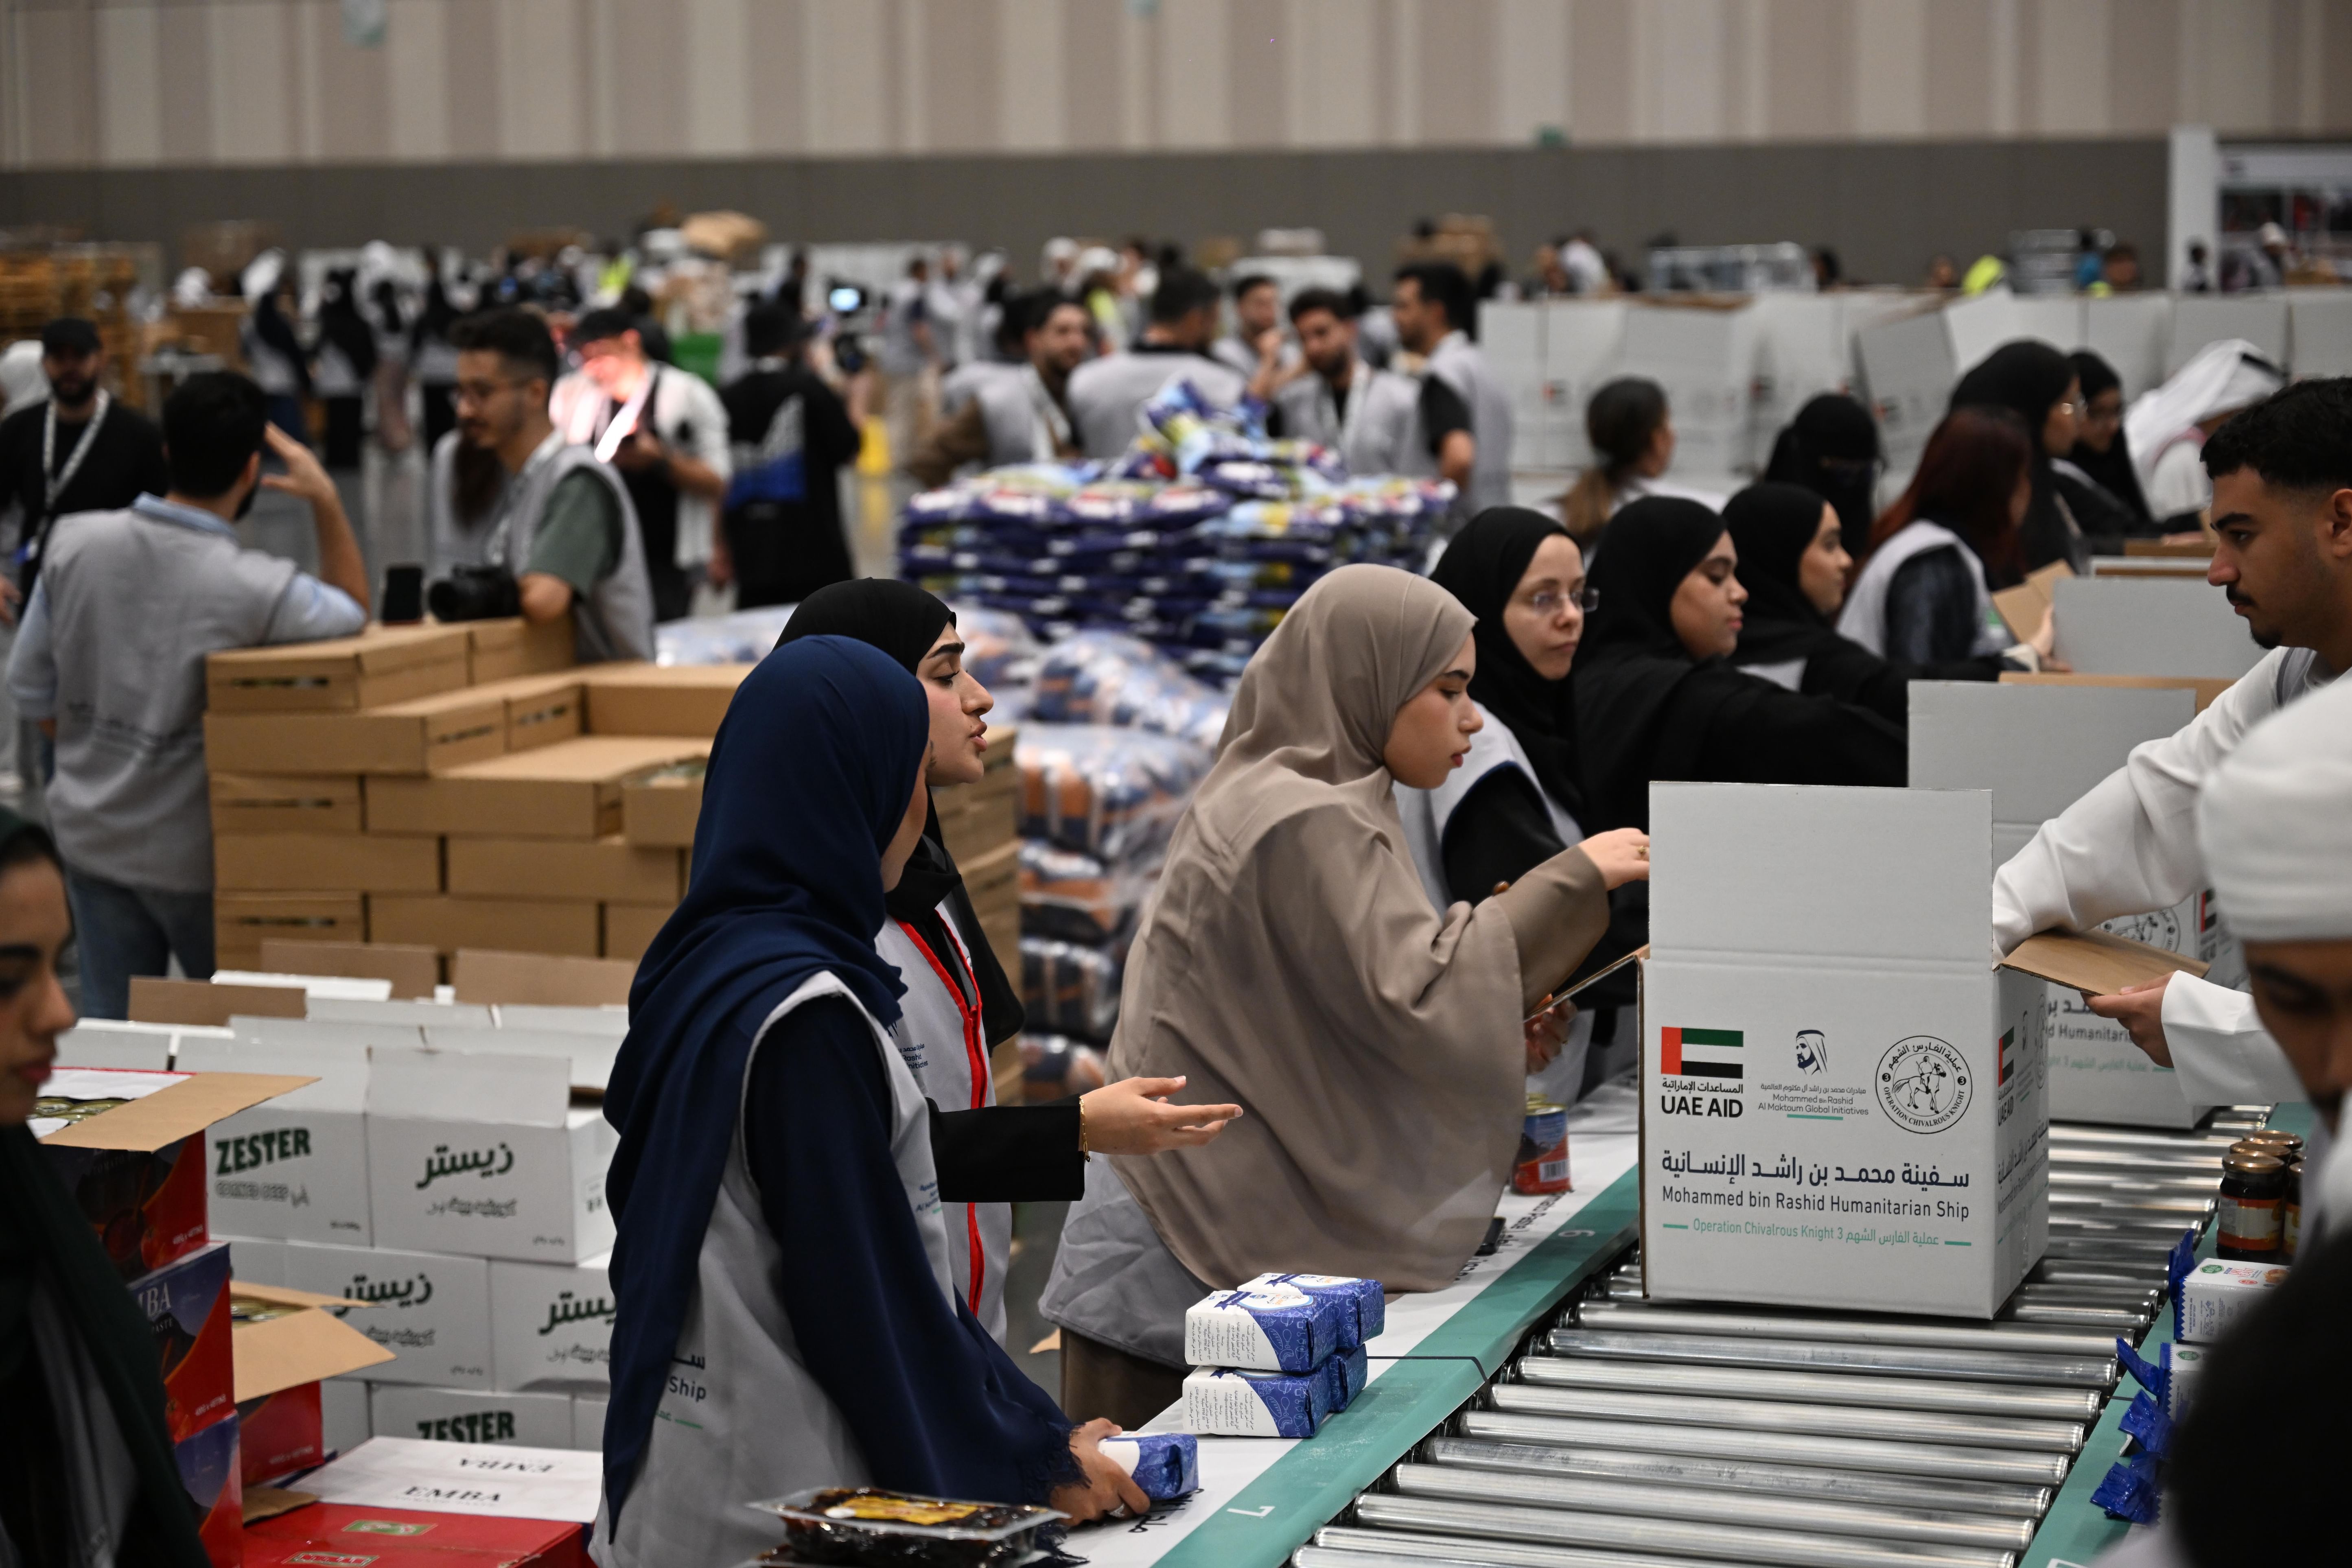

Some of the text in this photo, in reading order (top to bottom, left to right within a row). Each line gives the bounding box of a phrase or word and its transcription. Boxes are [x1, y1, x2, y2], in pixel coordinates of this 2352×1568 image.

[1888, 1042, 1962, 1073] عملية الفارس الشهم
[1662, 1078, 1744, 1094] المساعدات الإماراتية
[1761, 1083, 1782, 1091] العالمية
[1783, 1084, 1801, 1092] مكتوم
[1809, 1085, 1822, 1093] راشد
[1846, 1087, 1866, 1095] مبادرات
[1661, 1095, 1744, 1118] UAE AID
[1768, 1103, 1803, 1112] Maktoum
[1805, 1104, 1829, 1113] Global
[1832, 1106, 1868, 1115] Initiatives
[1773, 1093, 1818, 1103] Mohammed
[1828, 1096, 1853, 1104] Rashid
[1884, 1087, 1965, 1127] OPERATION CHIVALROUS KNIGHT
[215, 1128, 311, 1176] ZESTER
[416, 1143, 514, 1190] زيستر
[1662, 1150, 1969, 1192] سفينة محمد بن راشد الإنسانية
[1663, 1185, 1969, 1221] Mohammed bin Rashid Humanitarian Ship
[1693, 1218, 1843, 1242] Operation Chivalrous Knight 3
[1846, 1228, 1939, 1247] عملية الفارس الشهم
[2238, 1268, 2254, 1277] YEAST
[669, 1375, 706, 1402] Ship
[417, 1411, 515, 1443] ZESTER
[405, 1485, 501, 1502] EMBA
